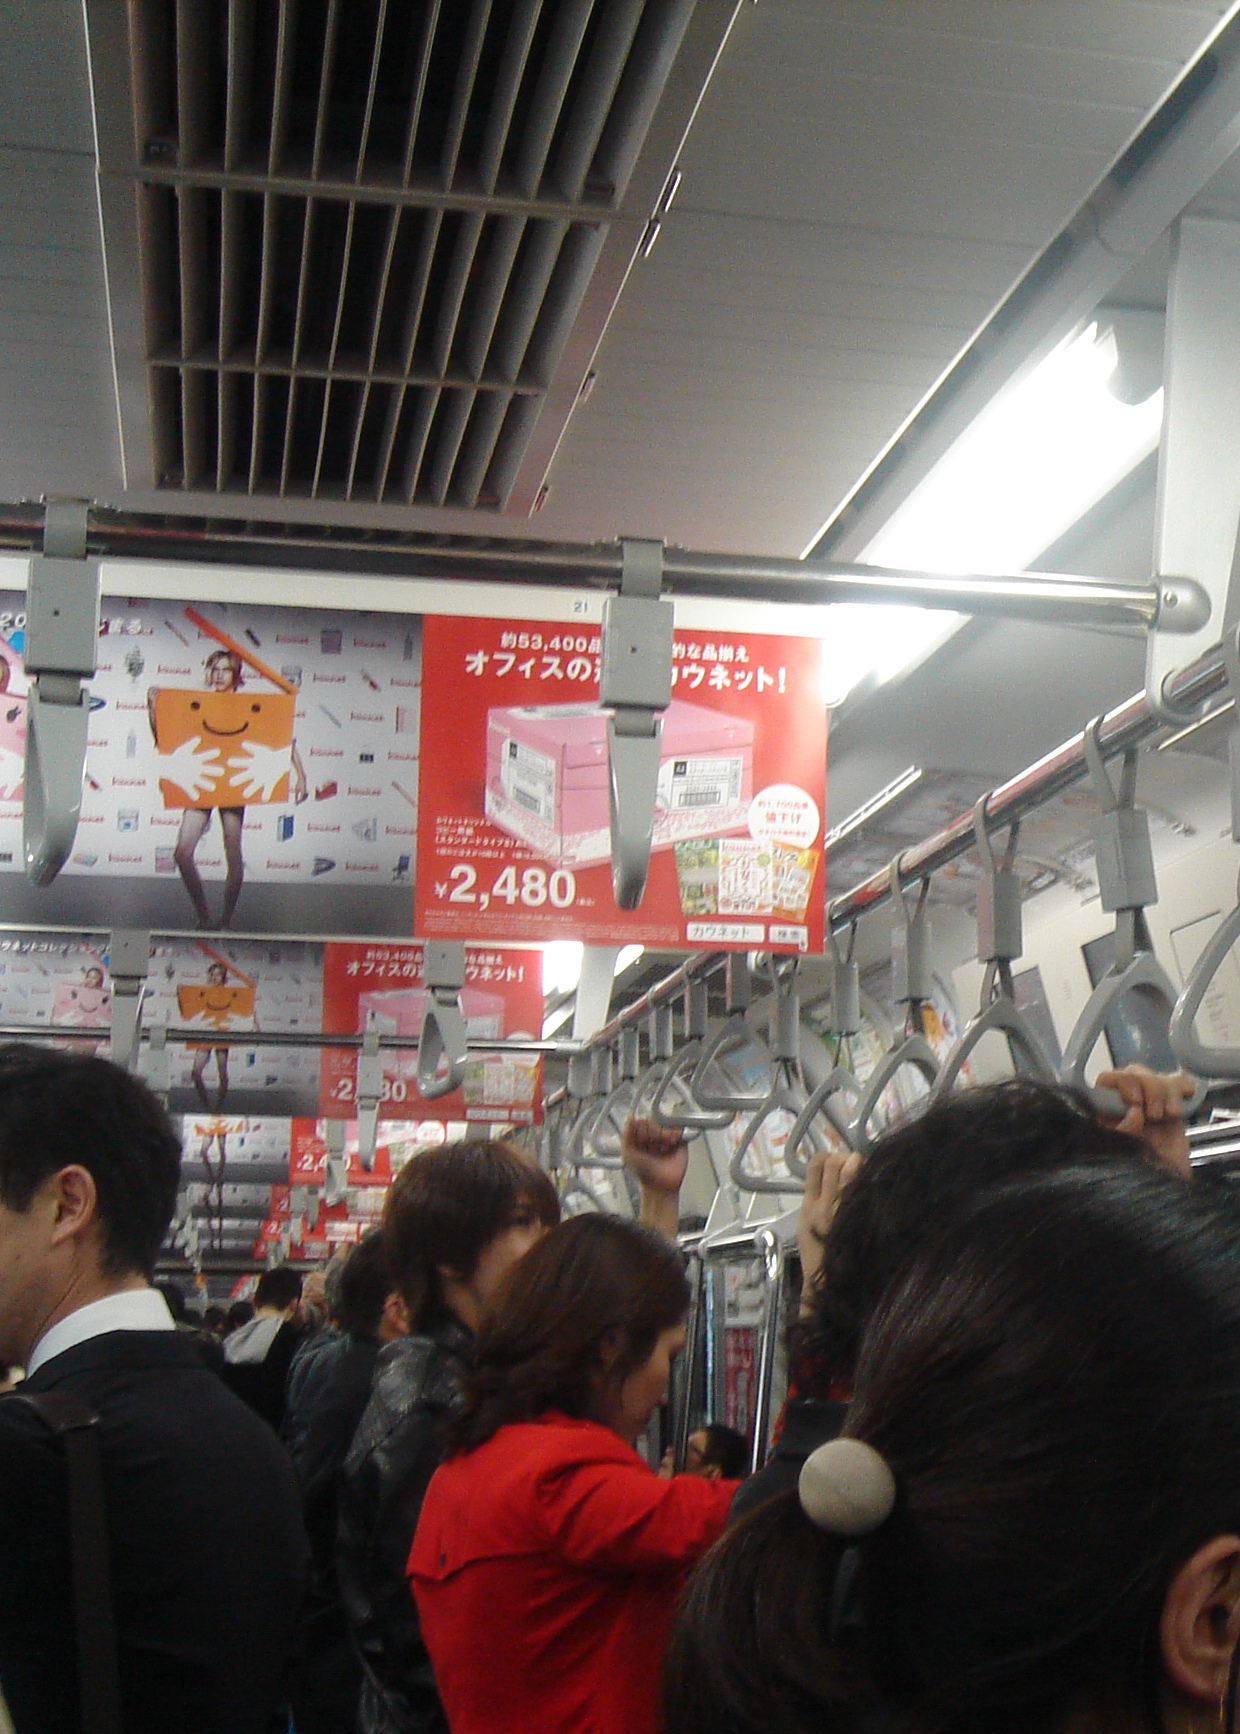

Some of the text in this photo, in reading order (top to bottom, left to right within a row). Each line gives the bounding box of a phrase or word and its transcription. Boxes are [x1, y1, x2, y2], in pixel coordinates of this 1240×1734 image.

[573, 601, 588, 613] 21
[465, 649, 601, 683] オフィスの
